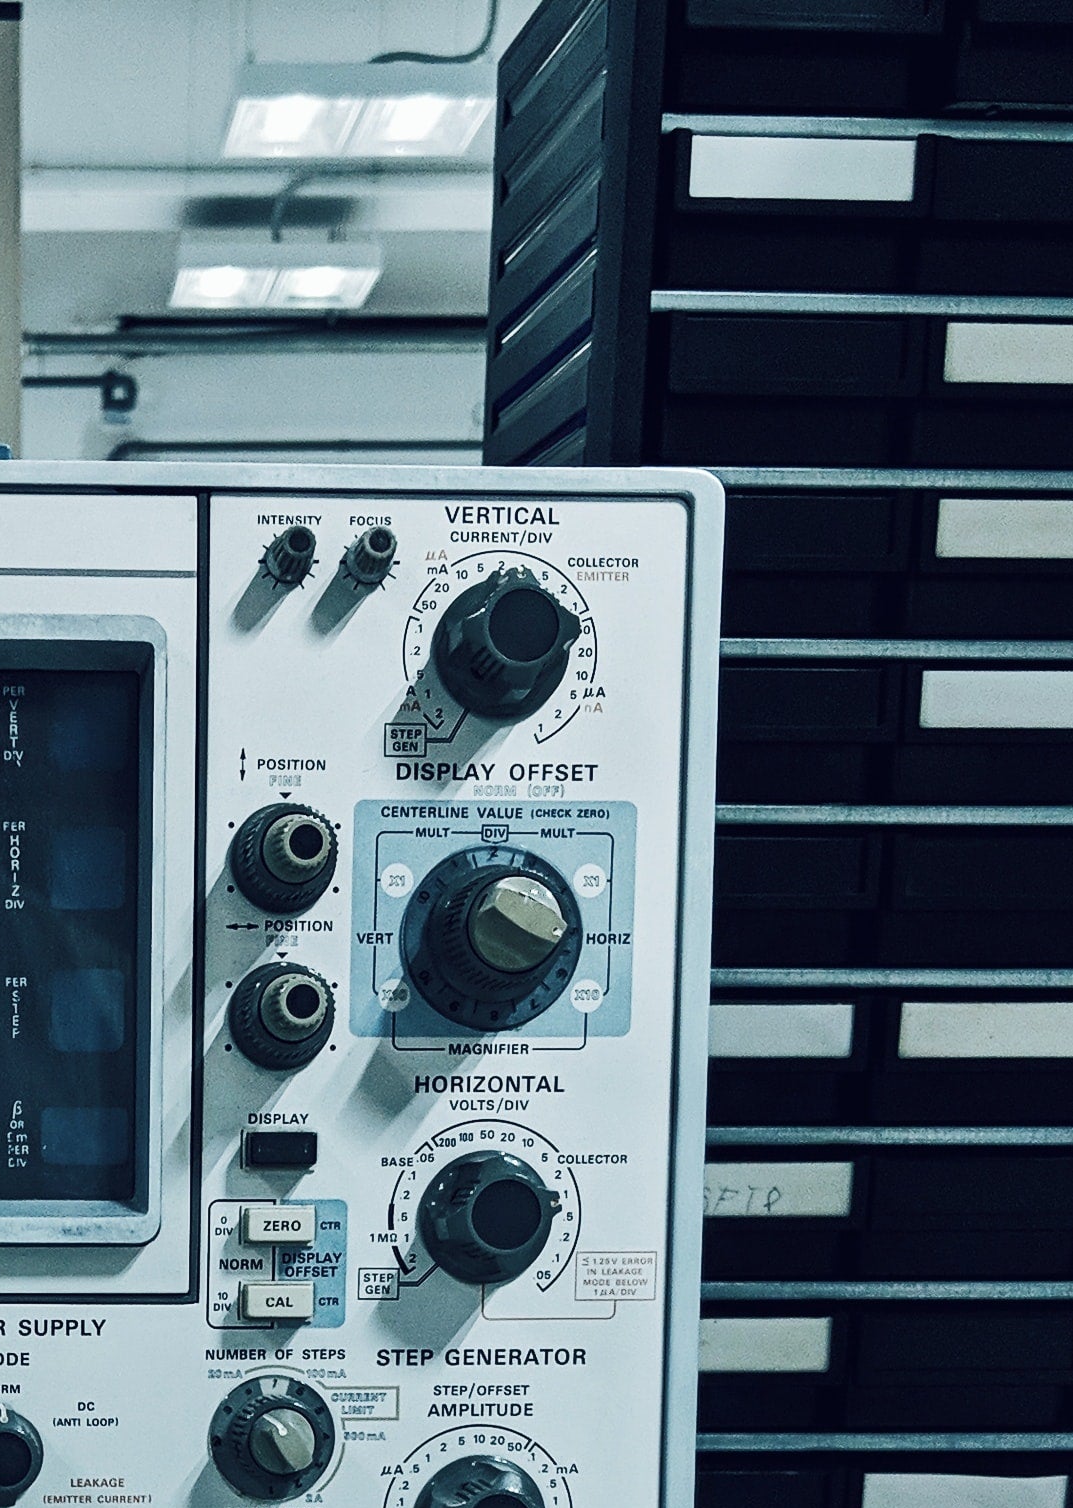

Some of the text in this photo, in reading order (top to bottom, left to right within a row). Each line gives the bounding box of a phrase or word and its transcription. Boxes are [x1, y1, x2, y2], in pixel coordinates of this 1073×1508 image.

[257, 515, 322, 526] INTENSITY
[350, 516, 392, 526] FOCUS
[446, 507, 559, 525] VERTICAL
[450, 531, 552, 546] CURRENT/DIV
[568, 557, 639, 569] COLLECTOR
[577, 571, 629, 581] EMITTER
[257, 759, 326, 770] POSITION
[396, 764, 598, 781] DISPLAY OFFSET
[381, 806, 610, 820] CENTERLINE VALUE (CHECK ZERO)
[416, 828, 450, 838] MULT
[484, 829, 505, 838] DIV
[540, 828, 574, 838] MULT
[265, 921, 332, 931] POSITION
[357, 934, 393, 944] VERT
[586, 934, 631, 944] HORIZ
[449, 1044, 529, 1055] MAGNIFIER
[415, 1076, 565, 1093] HORIZONTAL
[450, 1098, 529, 1112] VOLTS/DIV
[248, 1114, 309, 1124] DISPLAY
[381, 1157, 414, 1167] BASE
[557, 1154, 628, 1164] COLLECTOR
[263, 1221, 301, 1231] ZERO
[320, 1222, 341, 1230] CTR
[282, 1252, 342, 1264] DISPLAY
[219, 1259, 263, 1270] NORM
[285, 1266, 338, 1277] OFFSET
[364, 1273, 394, 1283] STEP
[365, 1285, 390, 1294] GEN
[266, 1297, 293, 1307] CAL
[19, 1319, 106, 1336] SUPPLY
[206, 1349, 345, 1360] NUMBER OF STEPS
[376, 1349, 586, 1366] STEP GENERATOR
[433, 1383, 530, 1398] STEP/OFFSET
[78, 1402, 94, 1411] DC
[428, 1404, 533, 1416] AMPLITUDE
[53, 1417, 119, 1427] (ANTI LOOP)
[70, 1478, 124, 1487] LEAKAGE
[43, 1494, 152, 1504] (EMITTER CURRENT)
